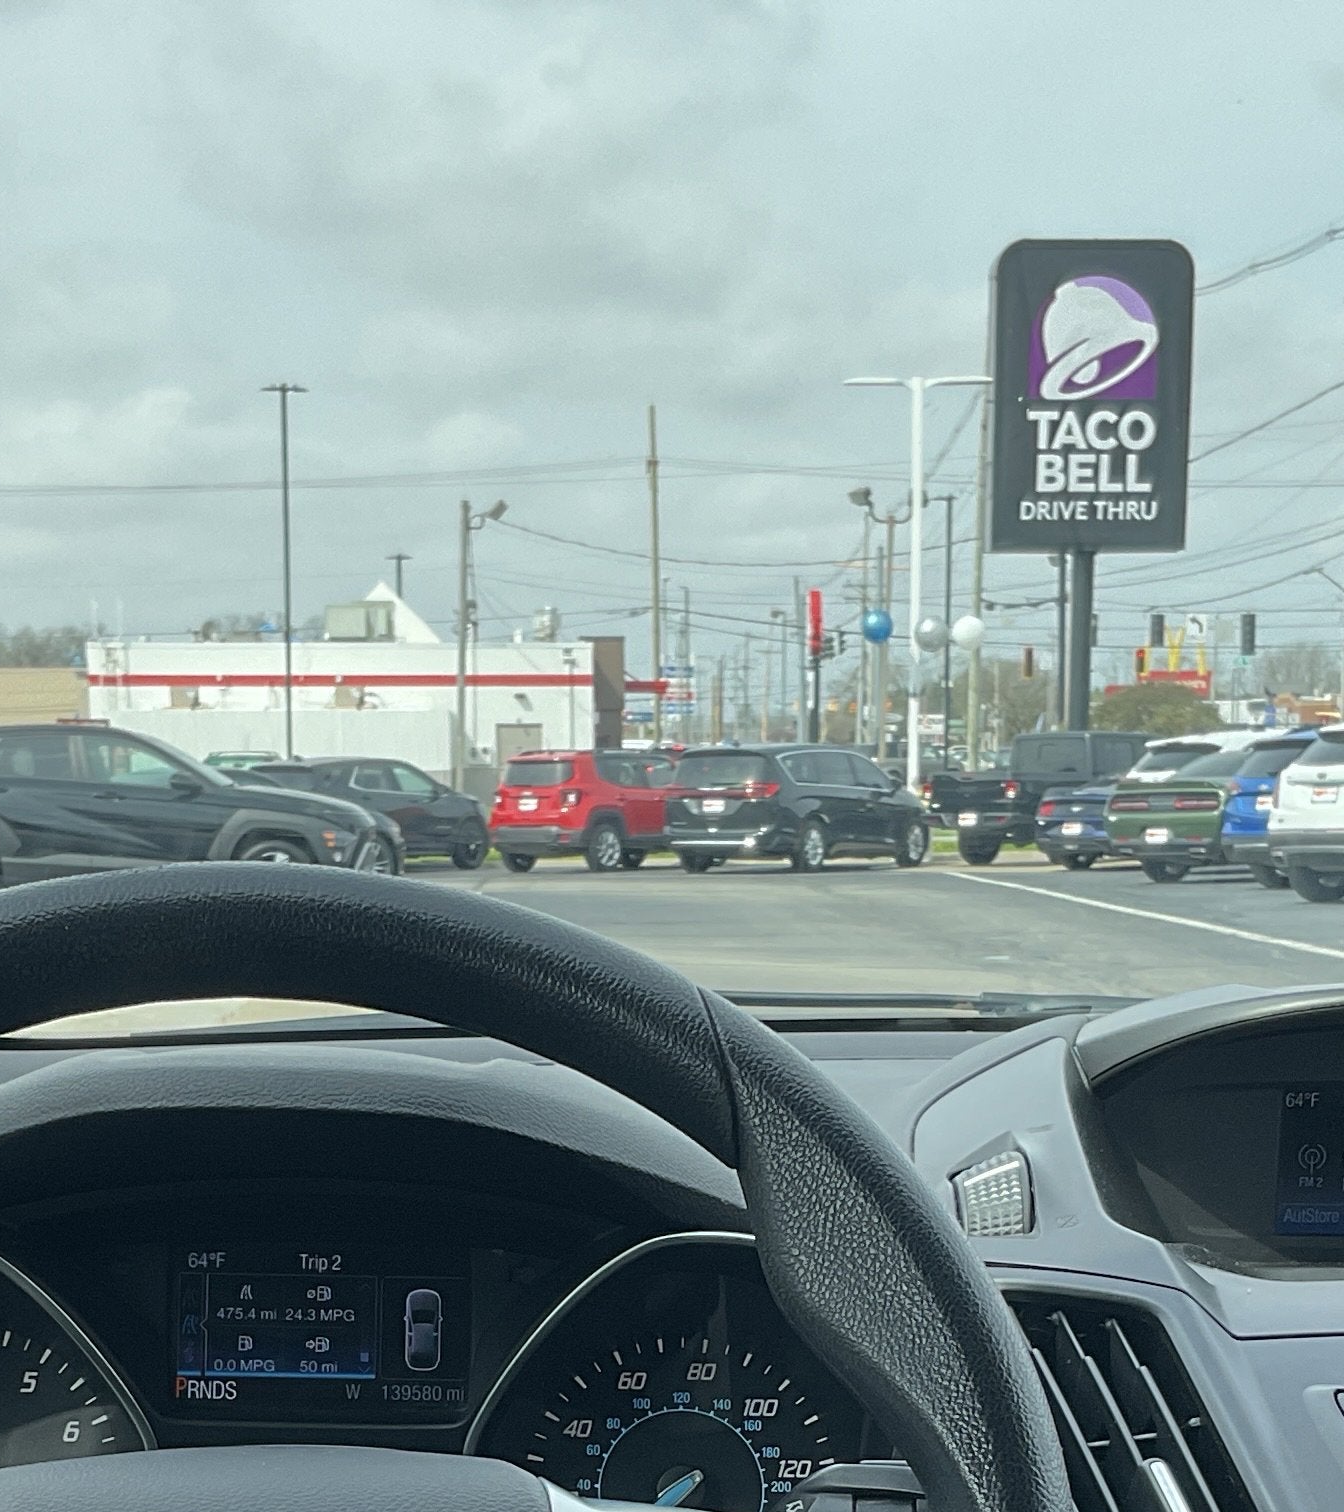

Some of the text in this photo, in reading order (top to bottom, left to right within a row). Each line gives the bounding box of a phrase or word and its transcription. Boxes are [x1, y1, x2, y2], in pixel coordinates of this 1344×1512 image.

[1026, 410, 1157, 450] TACO
[1035, 453, 1153, 493] BELL
[1019, 500, 1158, 521] DRIVE THRU
[1285, 1091, 1320, 1108] 64°F
[188, 1252, 227, 1268] 64°F
[299, 1253, 342, 1272] Trip 2
[216, 1307, 278, 1322] 475.4 mi
[285, 1308, 356, 1323] 24.3 MPG
[213, 1359, 276, 1374] 0.0 MPG
[299, 1360, 339, 1373] 50 mi
[686, 1362, 717, 1381] 80
[19, 1371, 39, 1393] 5
[175, 1376, 238, 1400] PRNDS
[618, 1372, 647, 1391] 60
[345, 1383, 466, 1402] W 139580 mi
[672, 1392, 691, 1404] 120
[632, 1398, 651, 1410] 100
[712, 1399, 732, 1411] 140
[743, 1398, 778, 1417] 100
[62, 1421, 80, 1442] 6
[563, 1419, 592, 1438] 40
[606, 1418, 621, 1430] 80
[743, 1420, 762, 1432] 160
[586, 1444, 601, 1456] 60
[761, 1446, 780, 1459] 180
[777, 1460, 812, 1479] 120
[576, 1479, 591, 1491] 40
[770, 1480, 792, 1493] 200
